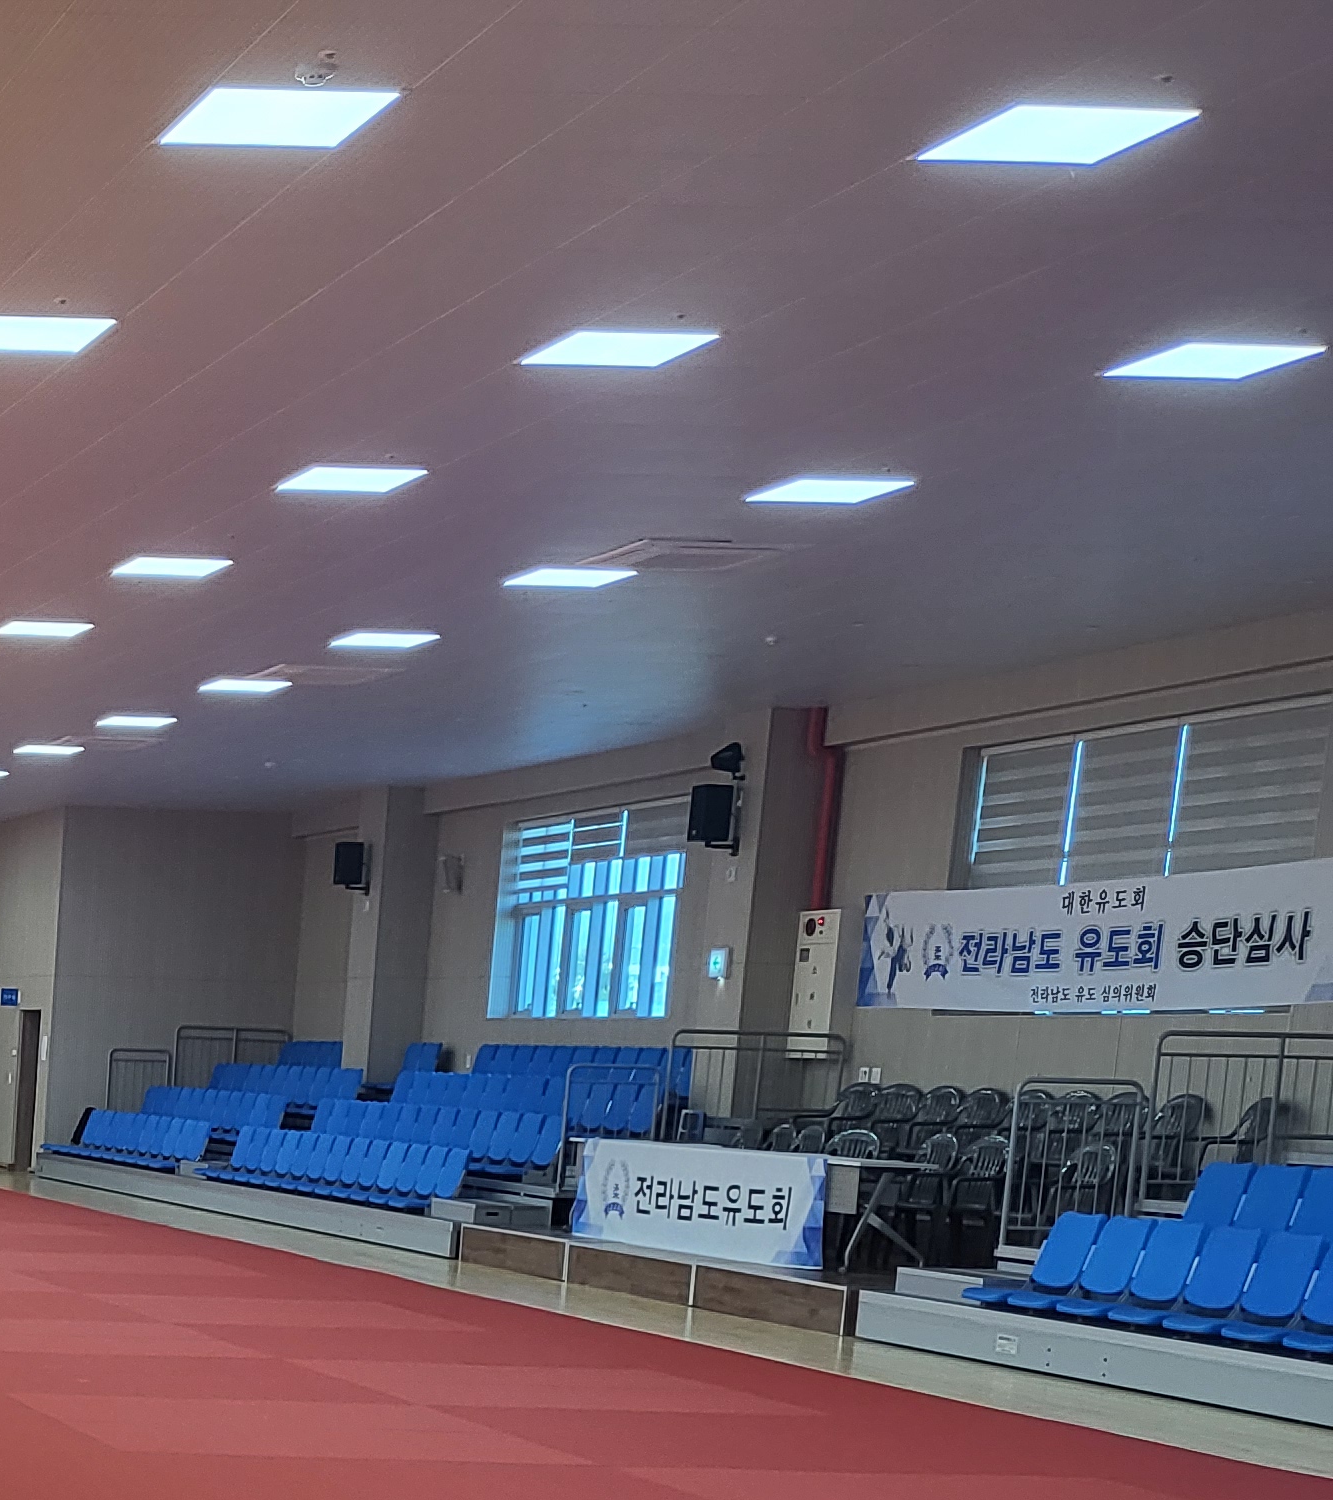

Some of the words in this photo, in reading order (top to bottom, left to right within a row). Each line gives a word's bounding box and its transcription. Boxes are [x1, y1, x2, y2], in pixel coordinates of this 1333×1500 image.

[1061, 886, 1148, 914] 대한유도회
[957, 929, 1062, 975] 전라남도
[1073, 923, 1164, 974] 유도회
[1176, 910, 1312, 970] 승단심사
[1029, 986, 1072, 1003] 전라남도
[1074, 985, 1097, 1002] 유도
[1100, 983, 1158, 1003] 심의위원회
[634, 1175, 793, 1231] 전라남도유도회
